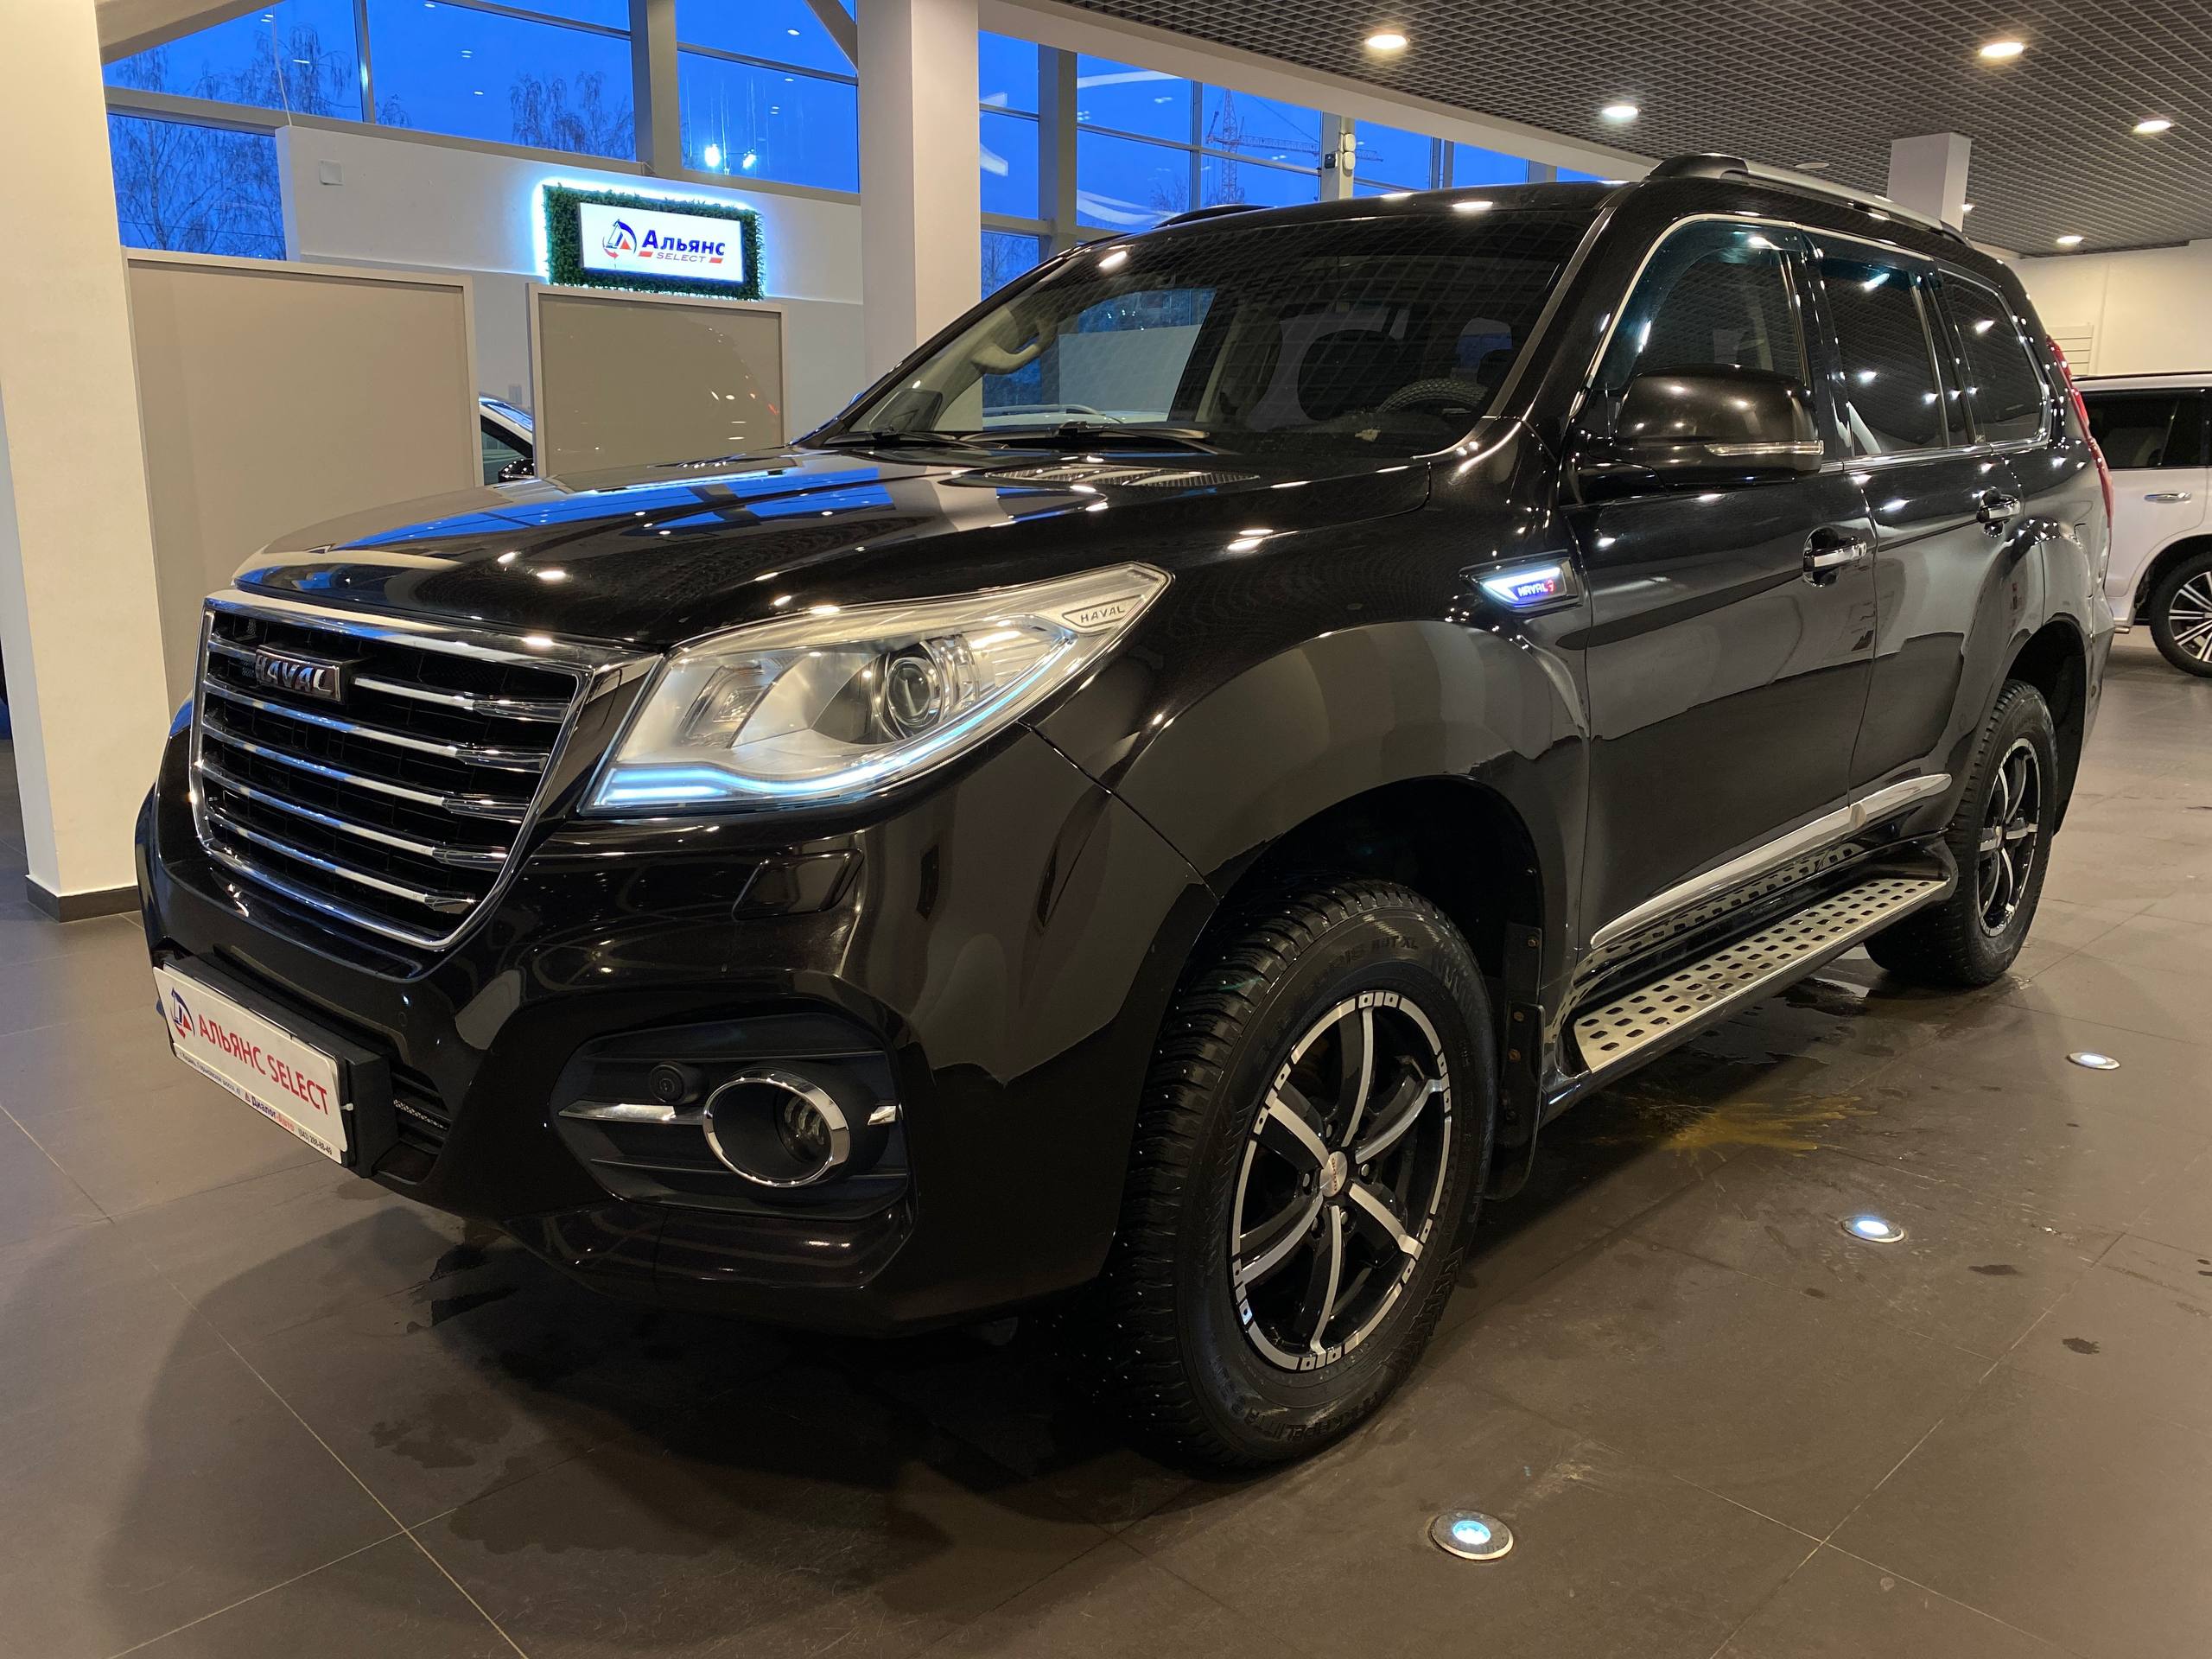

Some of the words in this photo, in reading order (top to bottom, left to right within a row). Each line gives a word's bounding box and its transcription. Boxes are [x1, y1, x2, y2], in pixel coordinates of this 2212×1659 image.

[642, 229, 726, 257] Альянс
[656, 251, 707, 264] SELECT
[1518, 582, 1549, 597] HAVAL
[1081, 606, 1125, 623] HAVAL
[256, 654, 333, 696] HAVAL
[198, 1014, 267, 1076] АЛЬЯНС
[267, 1053, 329, 1116] SELECT
